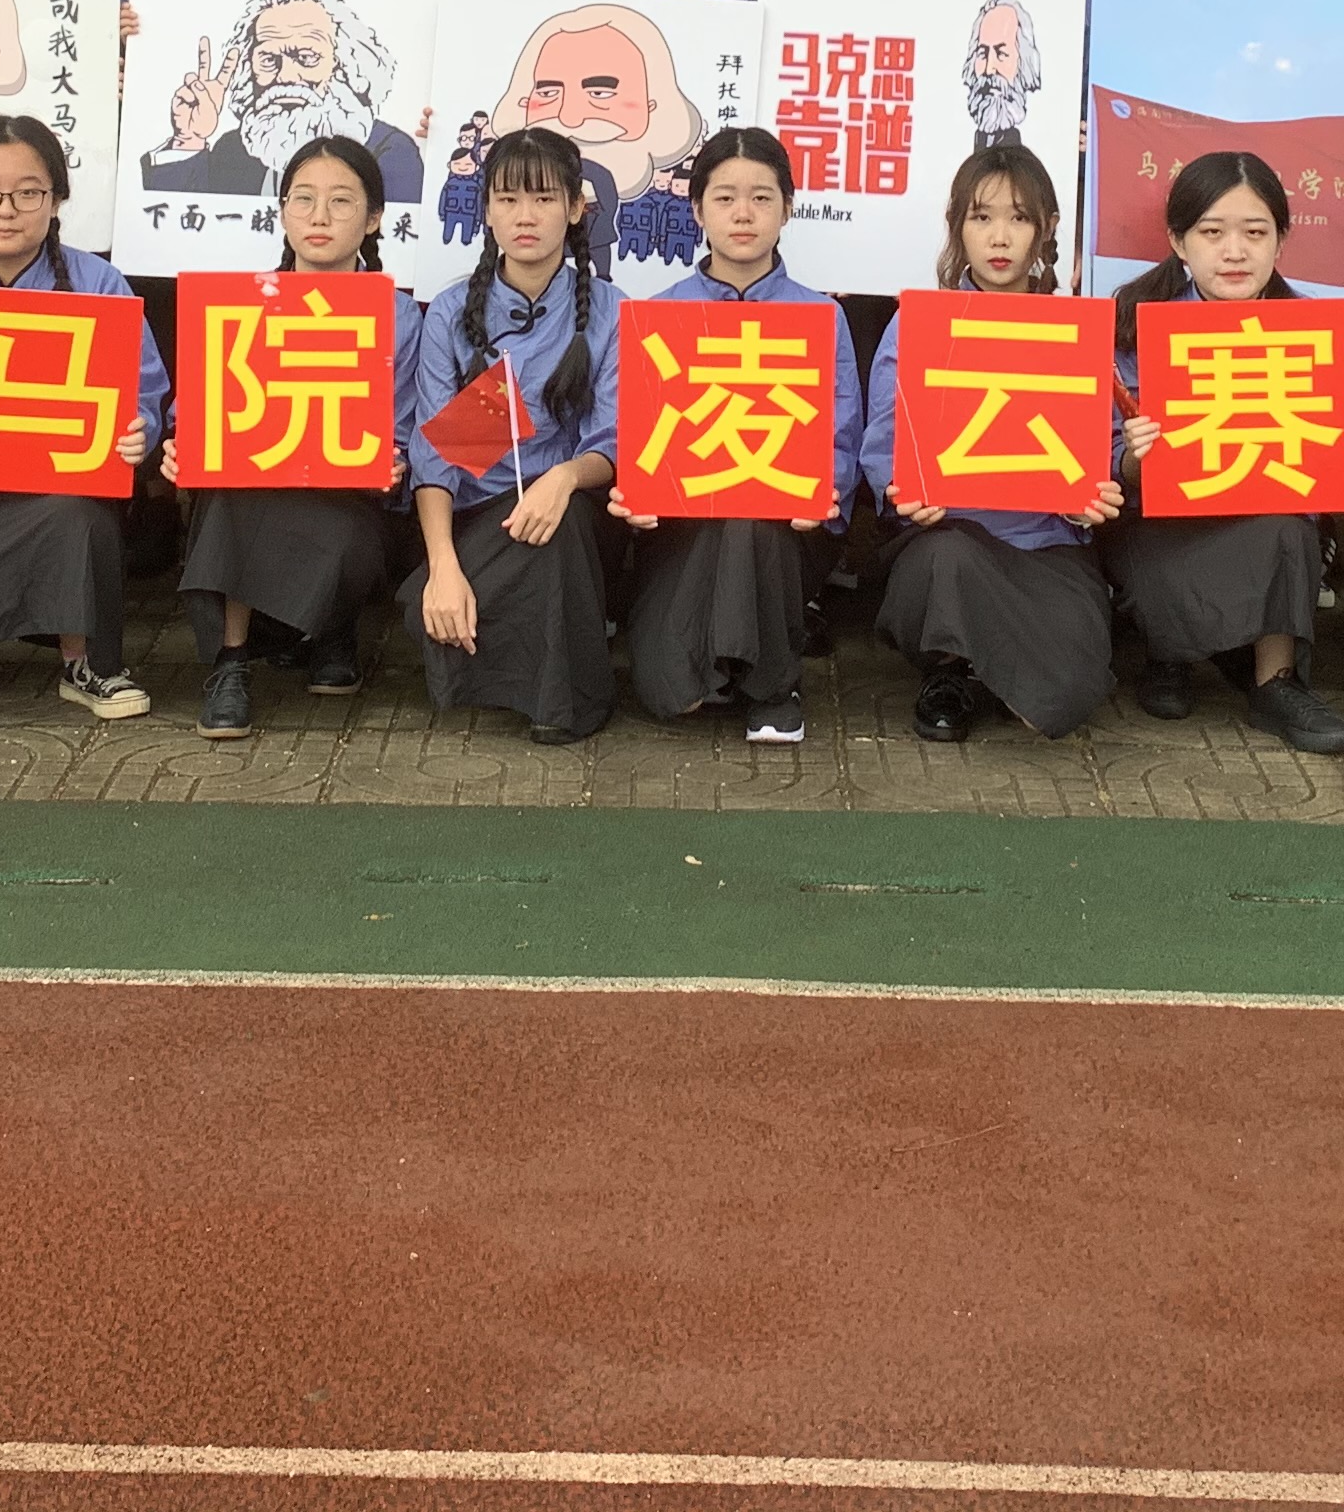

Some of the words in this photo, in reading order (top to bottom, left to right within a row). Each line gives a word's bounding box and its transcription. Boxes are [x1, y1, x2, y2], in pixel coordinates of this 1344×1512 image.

[716, 54, 744, 129] 拜托啦
[777, 31, 916, 101] 马克思
[775, 100, 914, 196] 靠谱
[143, 202, 419, 242] 下面一睹采
[822, 204, 853, 222] Marx
[204, 288, 382, 473] 院
[635, 320, 823, 501] 凌
[924, 318, 1097, 486] 云
[1161, 316, 1344, 501] 赛
